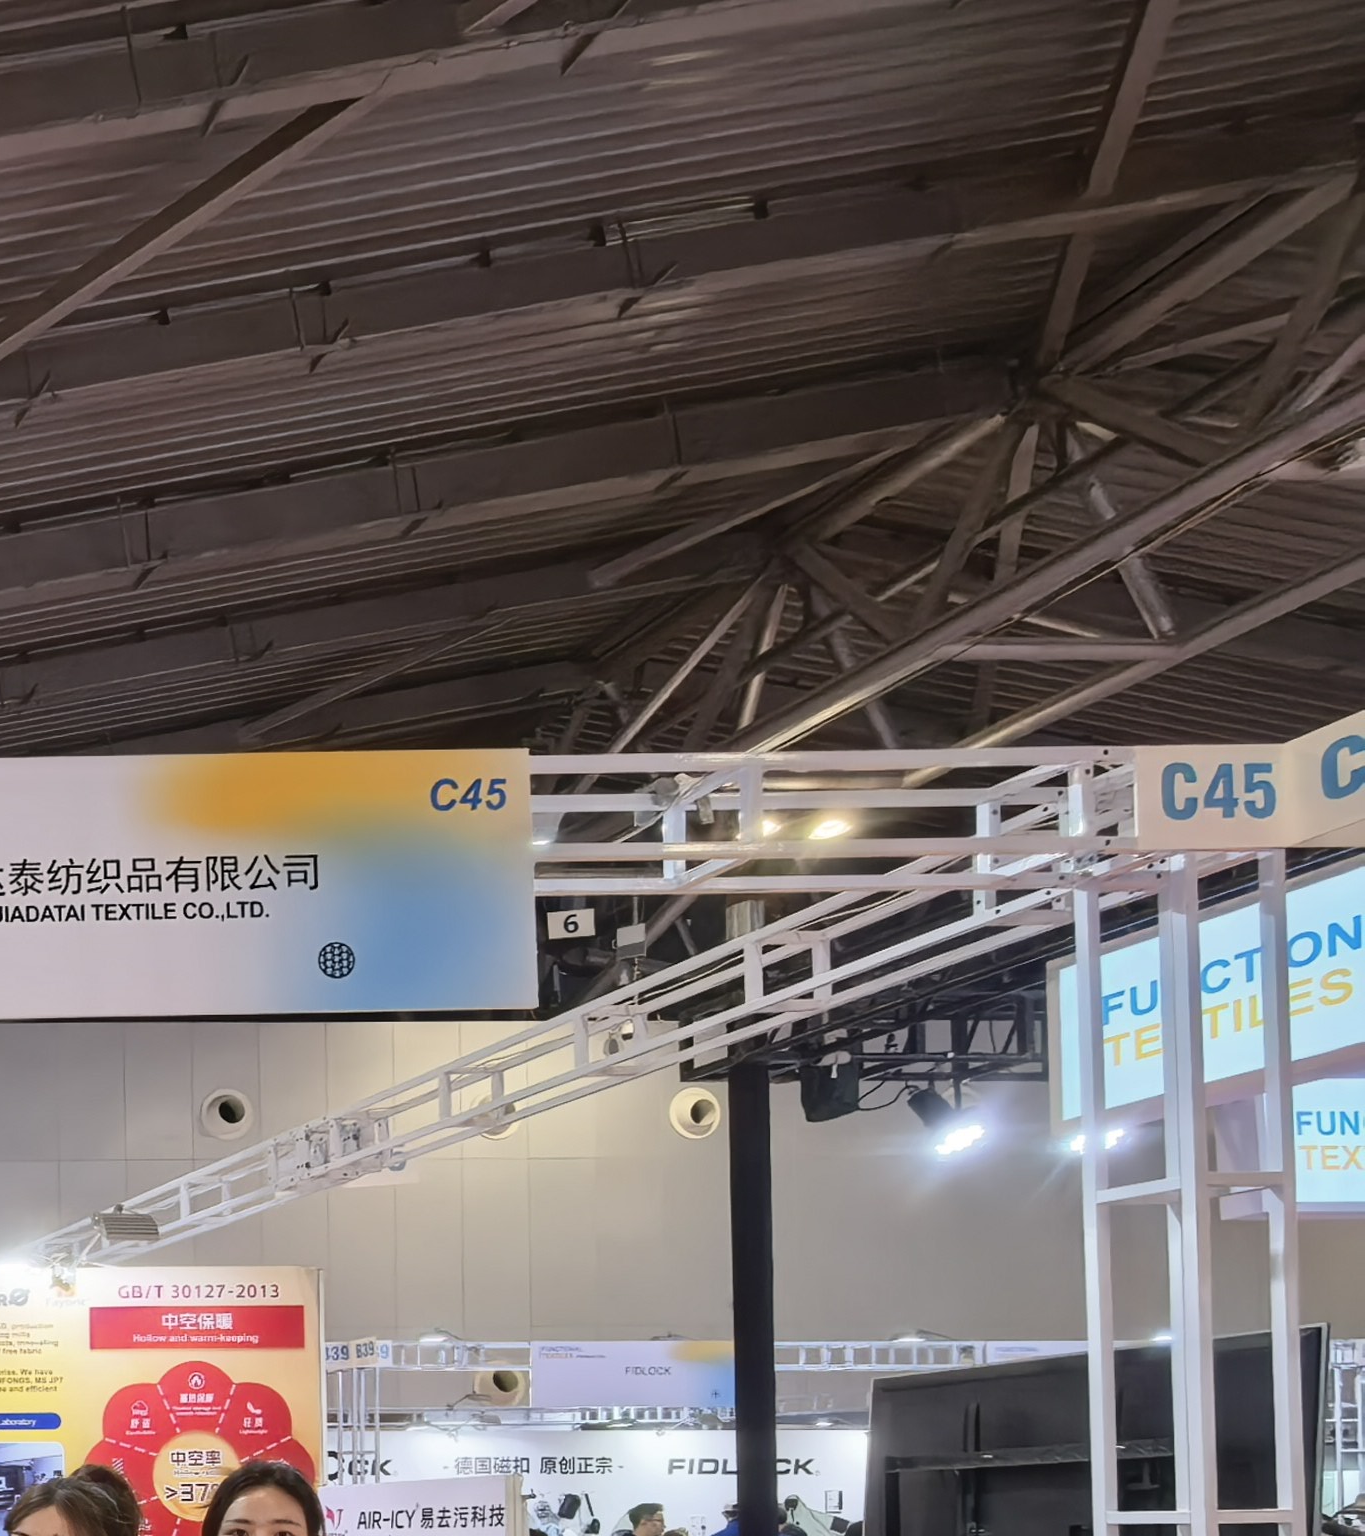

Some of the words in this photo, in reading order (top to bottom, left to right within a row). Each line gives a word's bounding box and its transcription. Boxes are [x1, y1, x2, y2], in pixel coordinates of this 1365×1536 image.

[429, 778, 507, 811] C45
[1161, 762, 1276, 820] C45
[92, 902, 176, 922] TEXTILE
[563, 914, 579, 933] 6
[1102, 915, 1362, 1025] FUCTON
[1103, 968, 1354, 1066] TETILES
[1296, 1111, 1365, 1136] FUN
[118, 1285, 164, 1299] GB/T
[172, 1284, 280, 1298] 30127-2013
[162, 1313, 234, 1330] 中空保暖
[356, 1343, 375, 1358] B39
[170, 1449, 222, 1467] 中空率
[455, 1457, 530, 1475] 德国磁扣
[539, 1457, 614, 1475] 原创正宗
[668, 1458, 816, 1475] FIDLCK
[357, 1510, 415, 1529] AIR-ICY
[420, 1504, 505, 1529] 易去污科技
